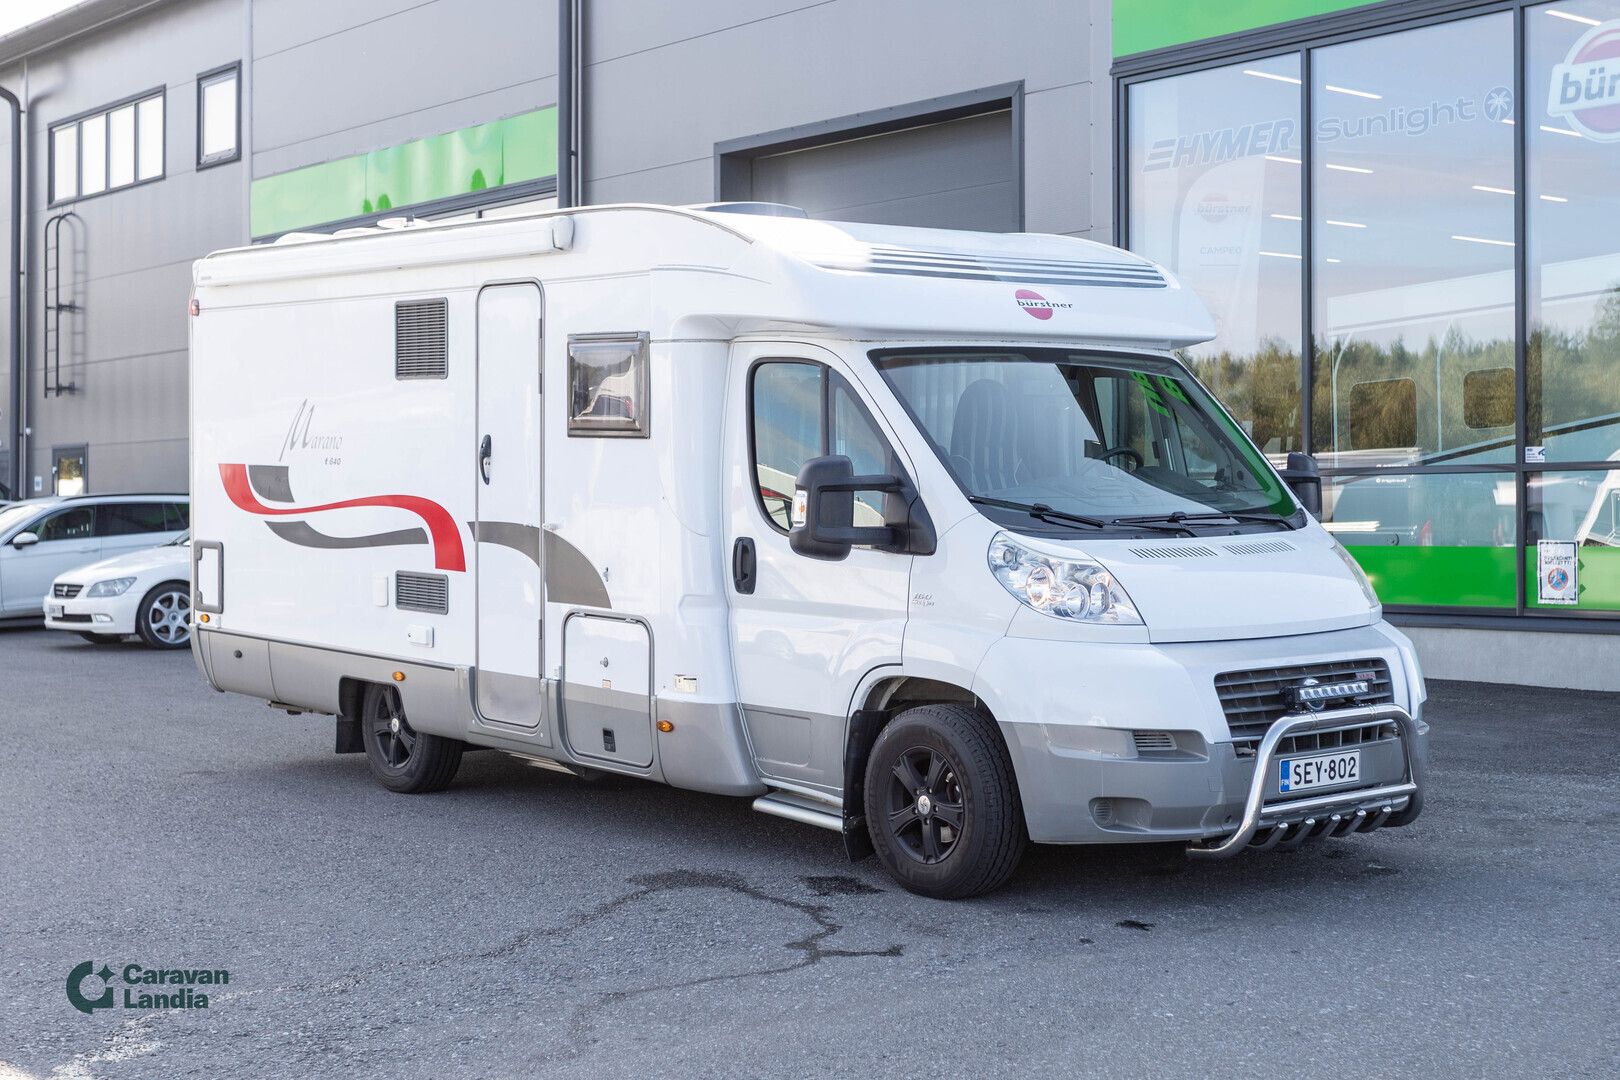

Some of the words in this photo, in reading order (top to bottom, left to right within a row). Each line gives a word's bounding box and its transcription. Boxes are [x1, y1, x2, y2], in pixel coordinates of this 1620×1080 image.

[1317, 97, 1476, 142] Sunlight
[1171, 118, 1295, 169] HYMER
[1016, 299, 1073, 309] bürstner
[279, 398, 343, 462] Marano
[1293, 756, 1357, 786] SEY-802
